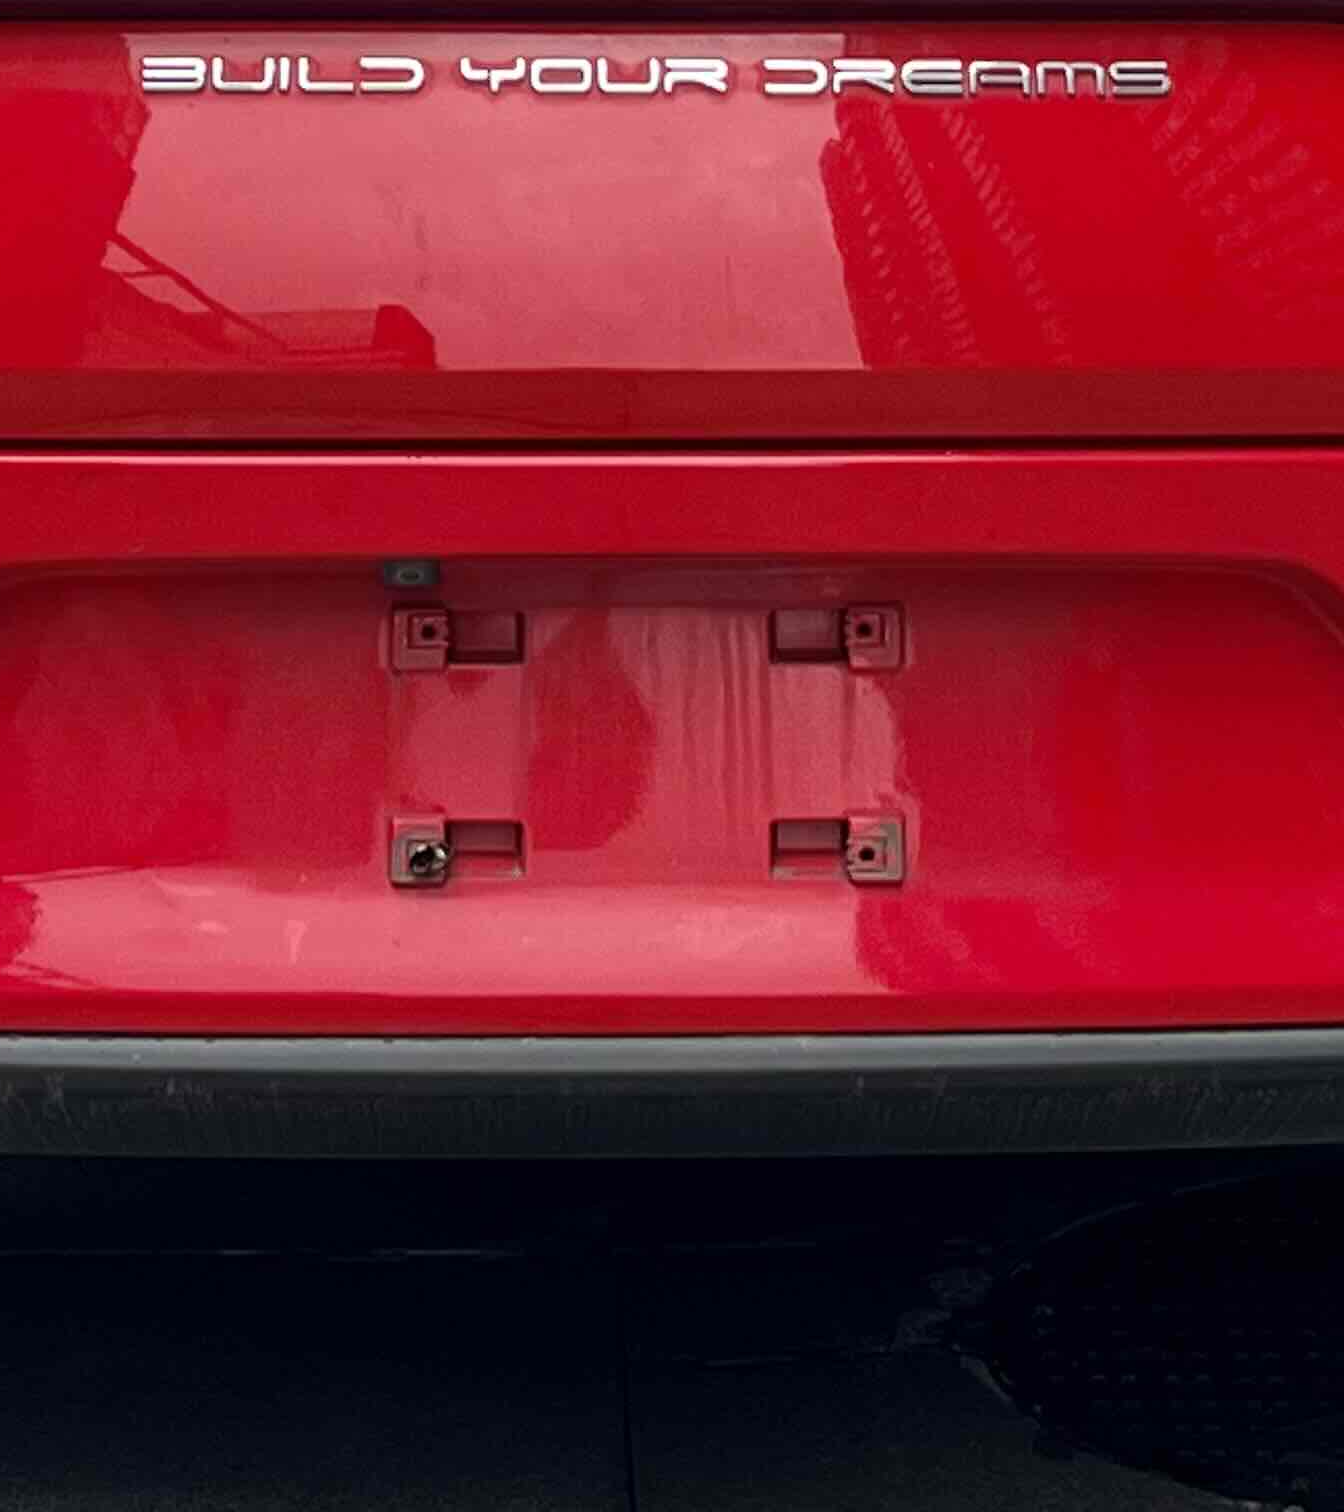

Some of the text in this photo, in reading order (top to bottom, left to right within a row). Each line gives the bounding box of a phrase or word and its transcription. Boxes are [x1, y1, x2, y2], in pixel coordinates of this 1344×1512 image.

[141, 56, 1173, 96] BUILD YOUR DREAMS
